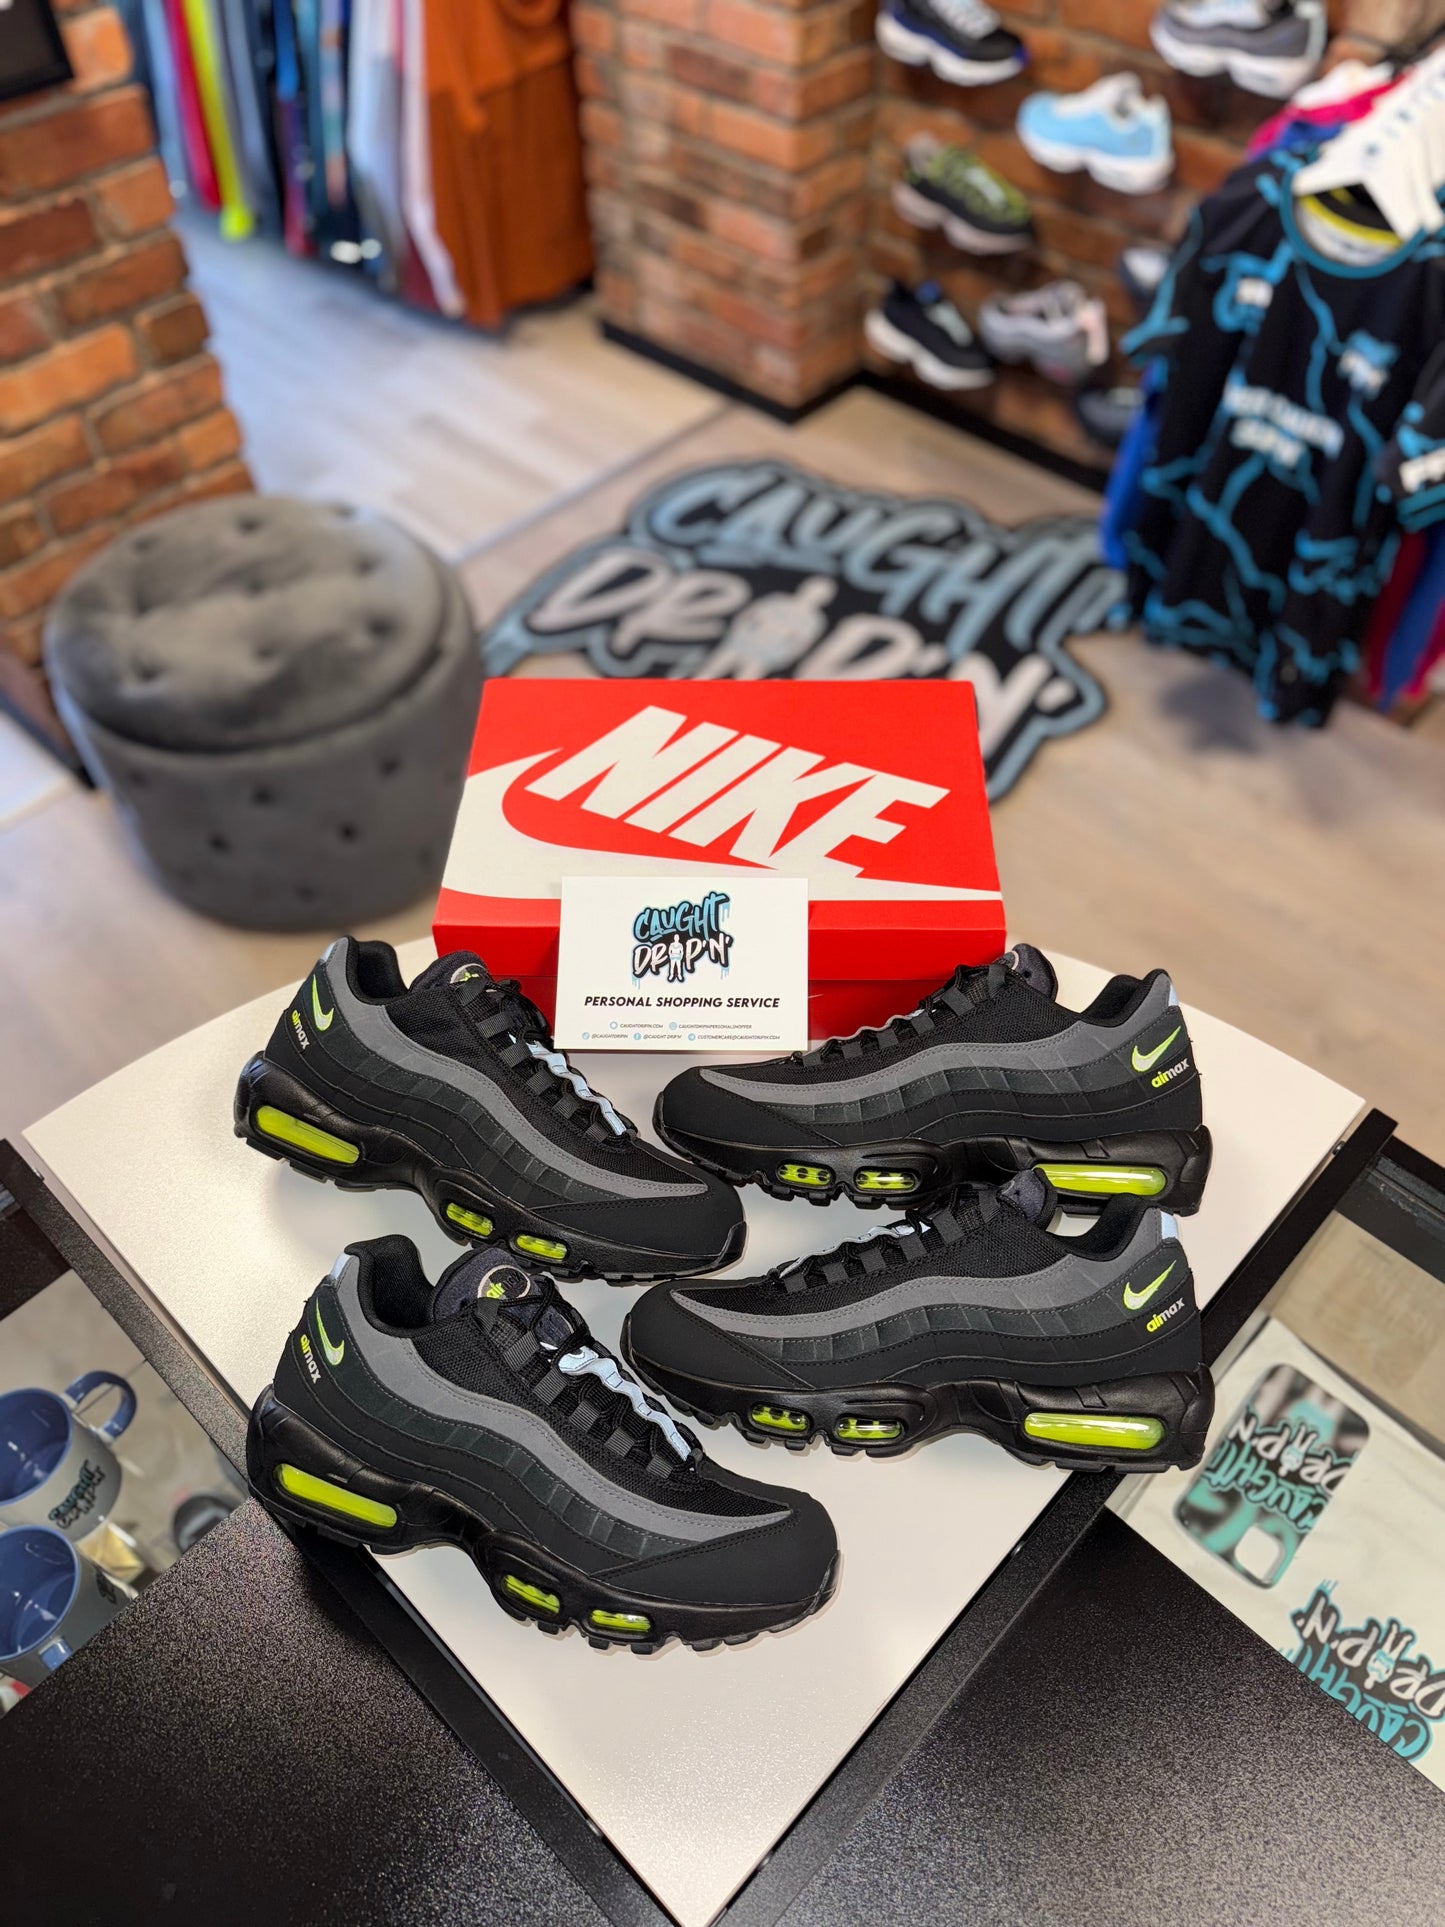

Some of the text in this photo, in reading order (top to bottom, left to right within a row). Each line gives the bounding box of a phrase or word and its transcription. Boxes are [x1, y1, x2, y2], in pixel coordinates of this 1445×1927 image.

[524, 705, 951, 878] NIKE
[632, 891, 730, 943] CAUGHT
[584, 996, 781, 1008] PERSONAL SHOPPING SERVICE
[1151, 1058, 1190, 1088] airmax
[1146, 1297, 1185, 1332] airmax
[300, 1333, 321, 1385] airmax
